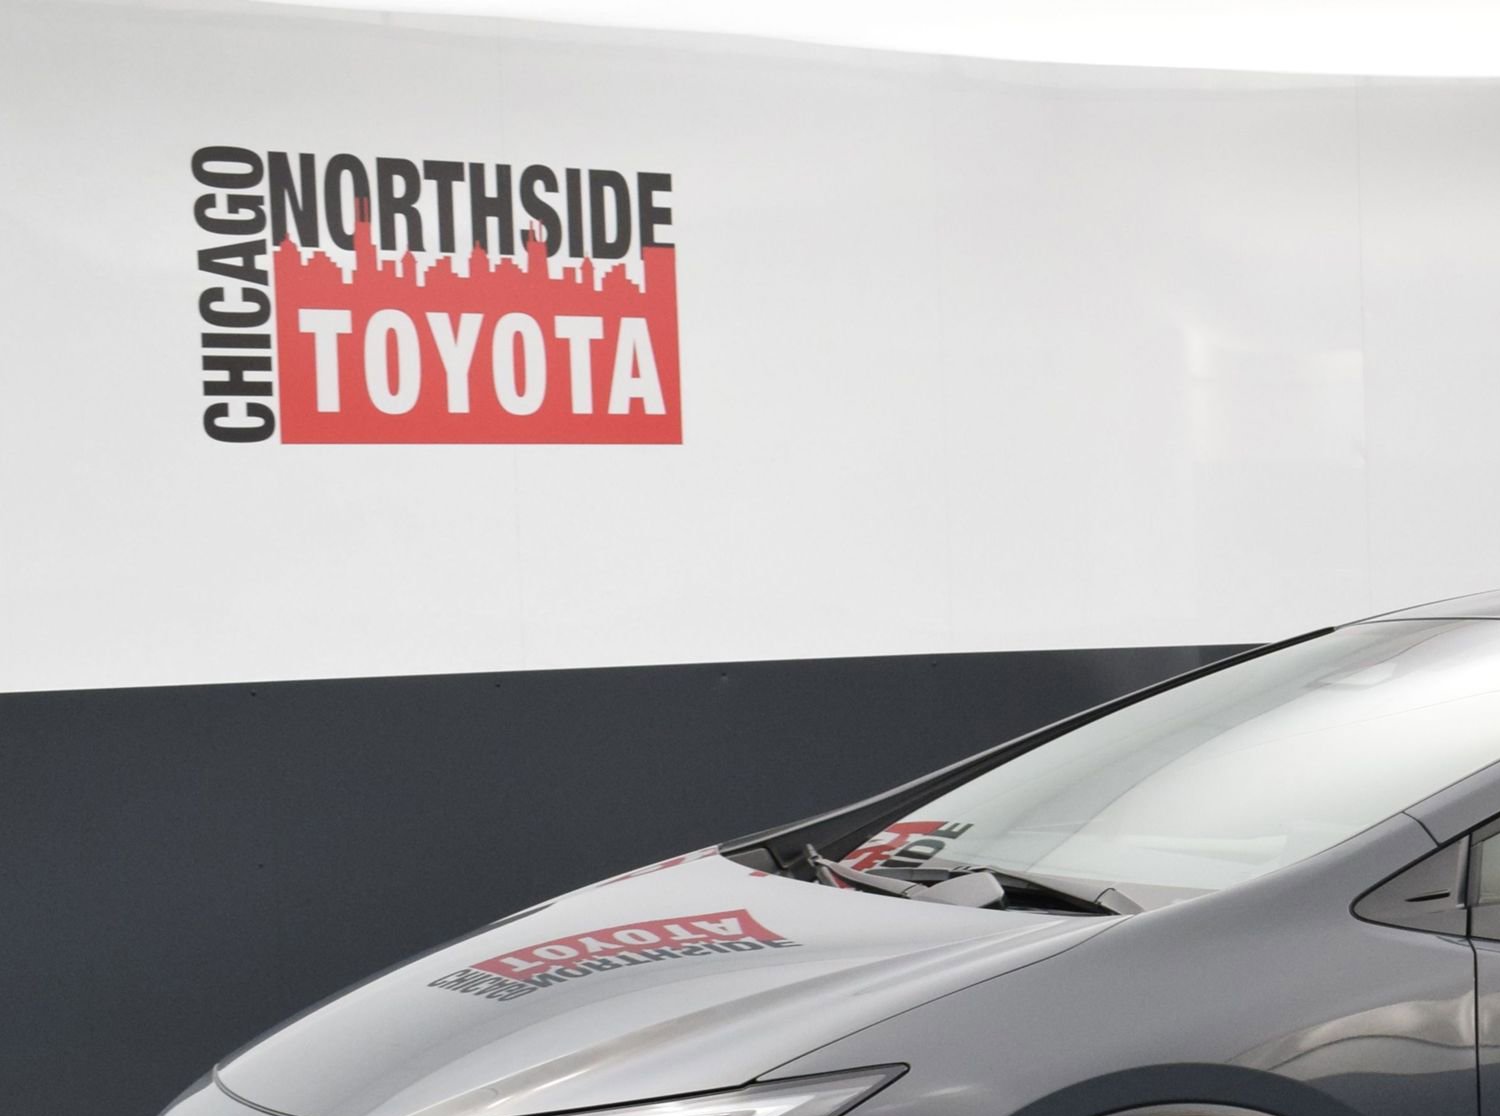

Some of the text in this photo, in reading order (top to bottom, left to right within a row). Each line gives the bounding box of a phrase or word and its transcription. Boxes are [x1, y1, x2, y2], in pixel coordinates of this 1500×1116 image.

[267, 151, 675, 261] NORTHSIDE
[191, 145, 276, 443] CHICAGO
[298, 307, 667, 416] TOYOTA
